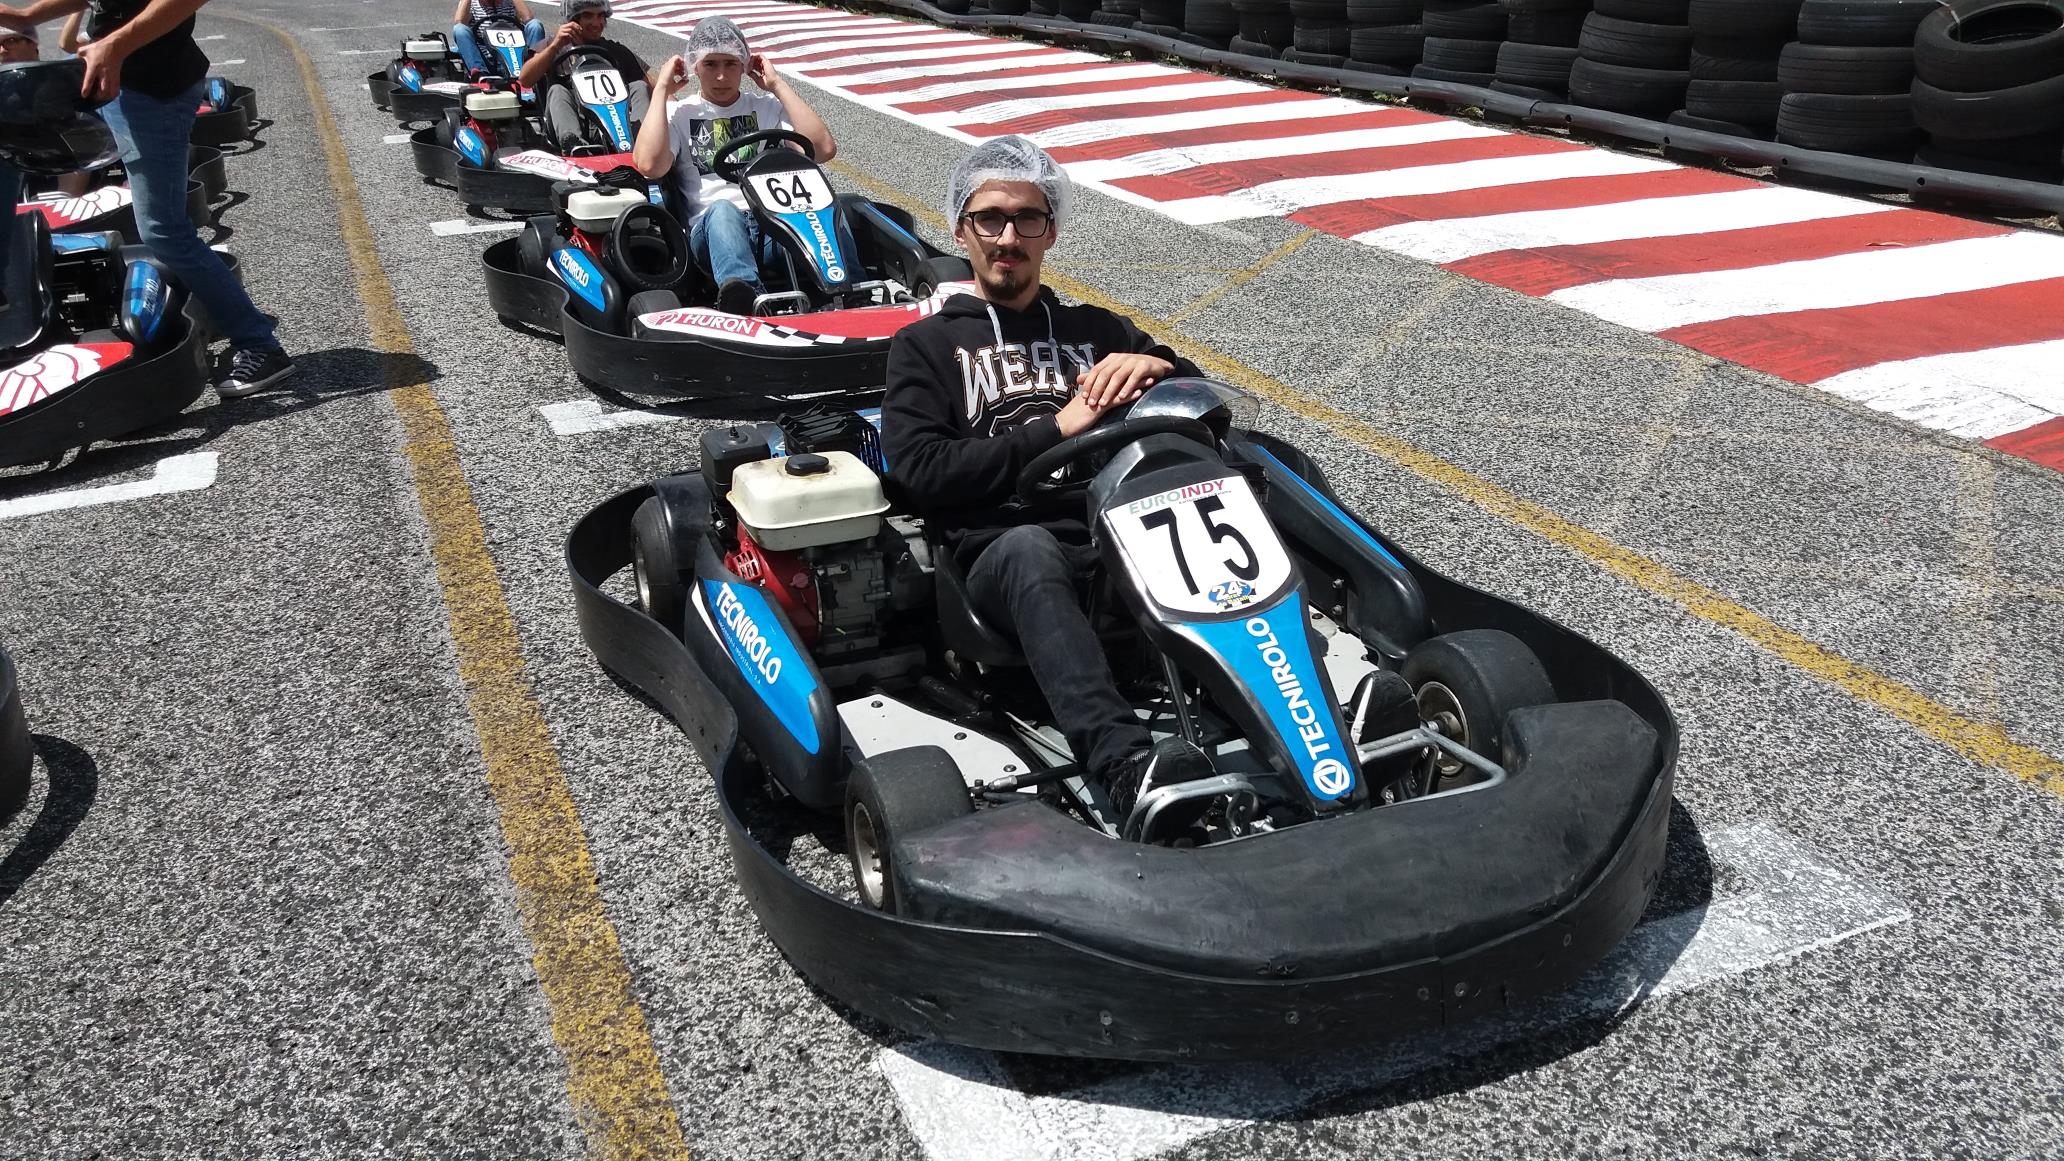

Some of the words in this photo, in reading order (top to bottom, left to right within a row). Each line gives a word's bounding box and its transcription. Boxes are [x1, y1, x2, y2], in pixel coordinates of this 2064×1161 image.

[495, 31, 517, 45] 61
[584, 73, 617, 99] 70
[765, 174, 813, 208] 64
[806, 211, 838, 267] TECNIROLO
[682, 313, 756, 335] HURON
[1128, 479, 1225, 515] EUROINDY
[1139, 494, 1260, 596] 75
[716, 581, 782, 685] TECNIROLO
[1245, 617, 1331, 761] TECNIROLO
